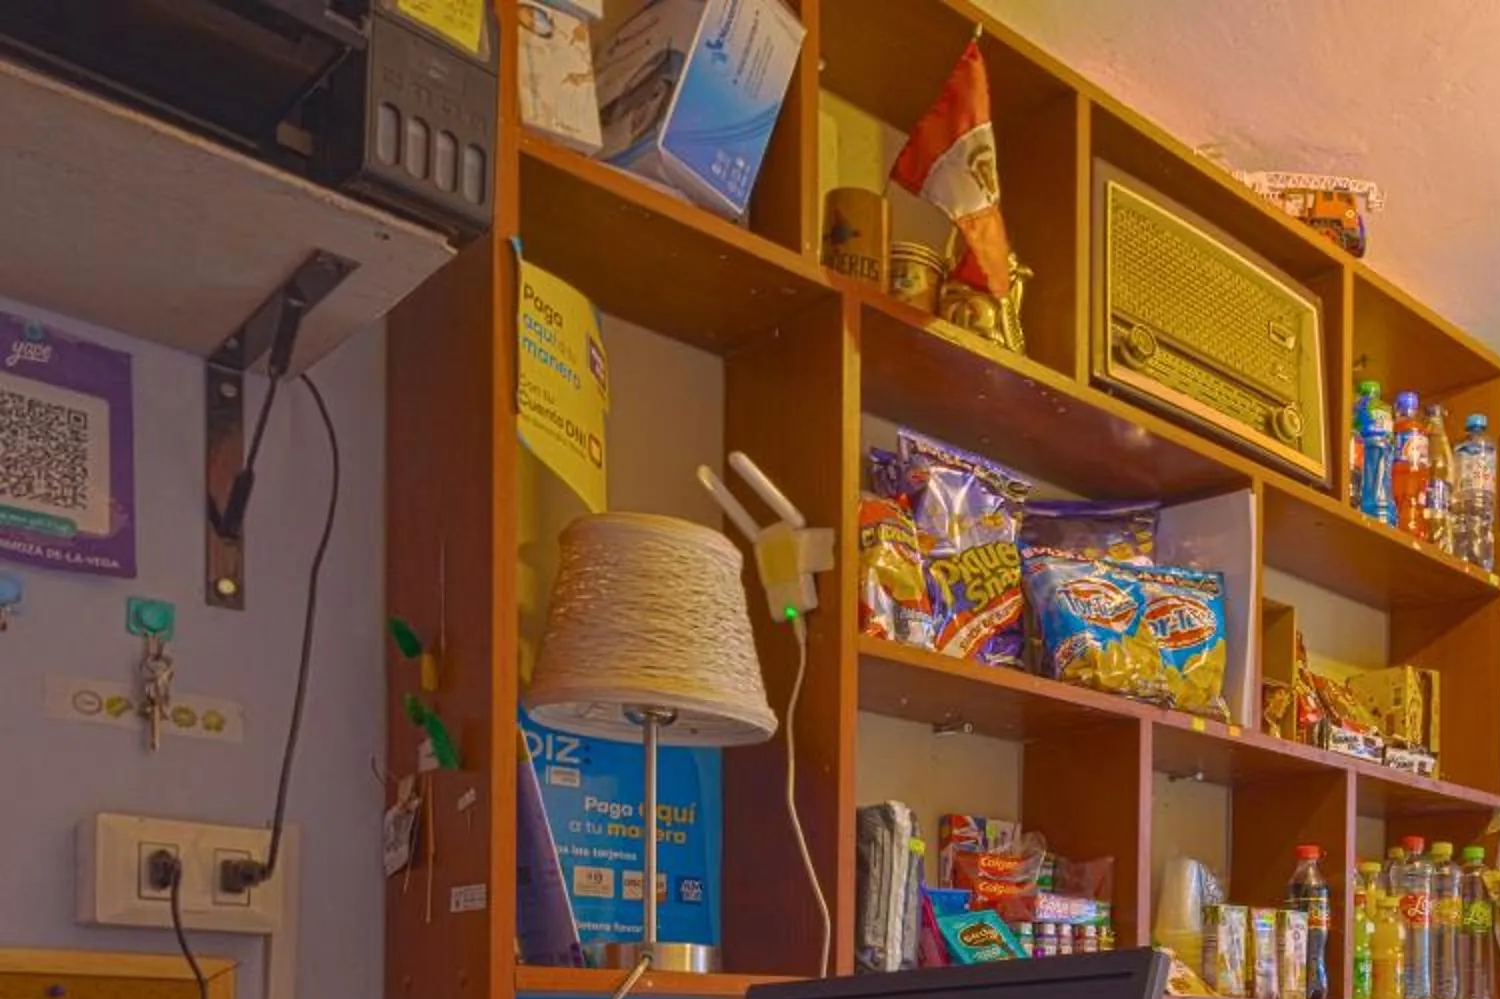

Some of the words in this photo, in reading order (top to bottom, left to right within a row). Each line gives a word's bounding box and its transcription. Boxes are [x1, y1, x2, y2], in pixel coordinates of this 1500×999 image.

[523, 284, 564, 328] Paga
[929, 543, 1022, 608] Pique
[965, 567, 1022, 612] Sna
[584, 796, 634, 819] Paga
[586, 820, 602, 835] tu
[607, 822, 686, 844] maera
